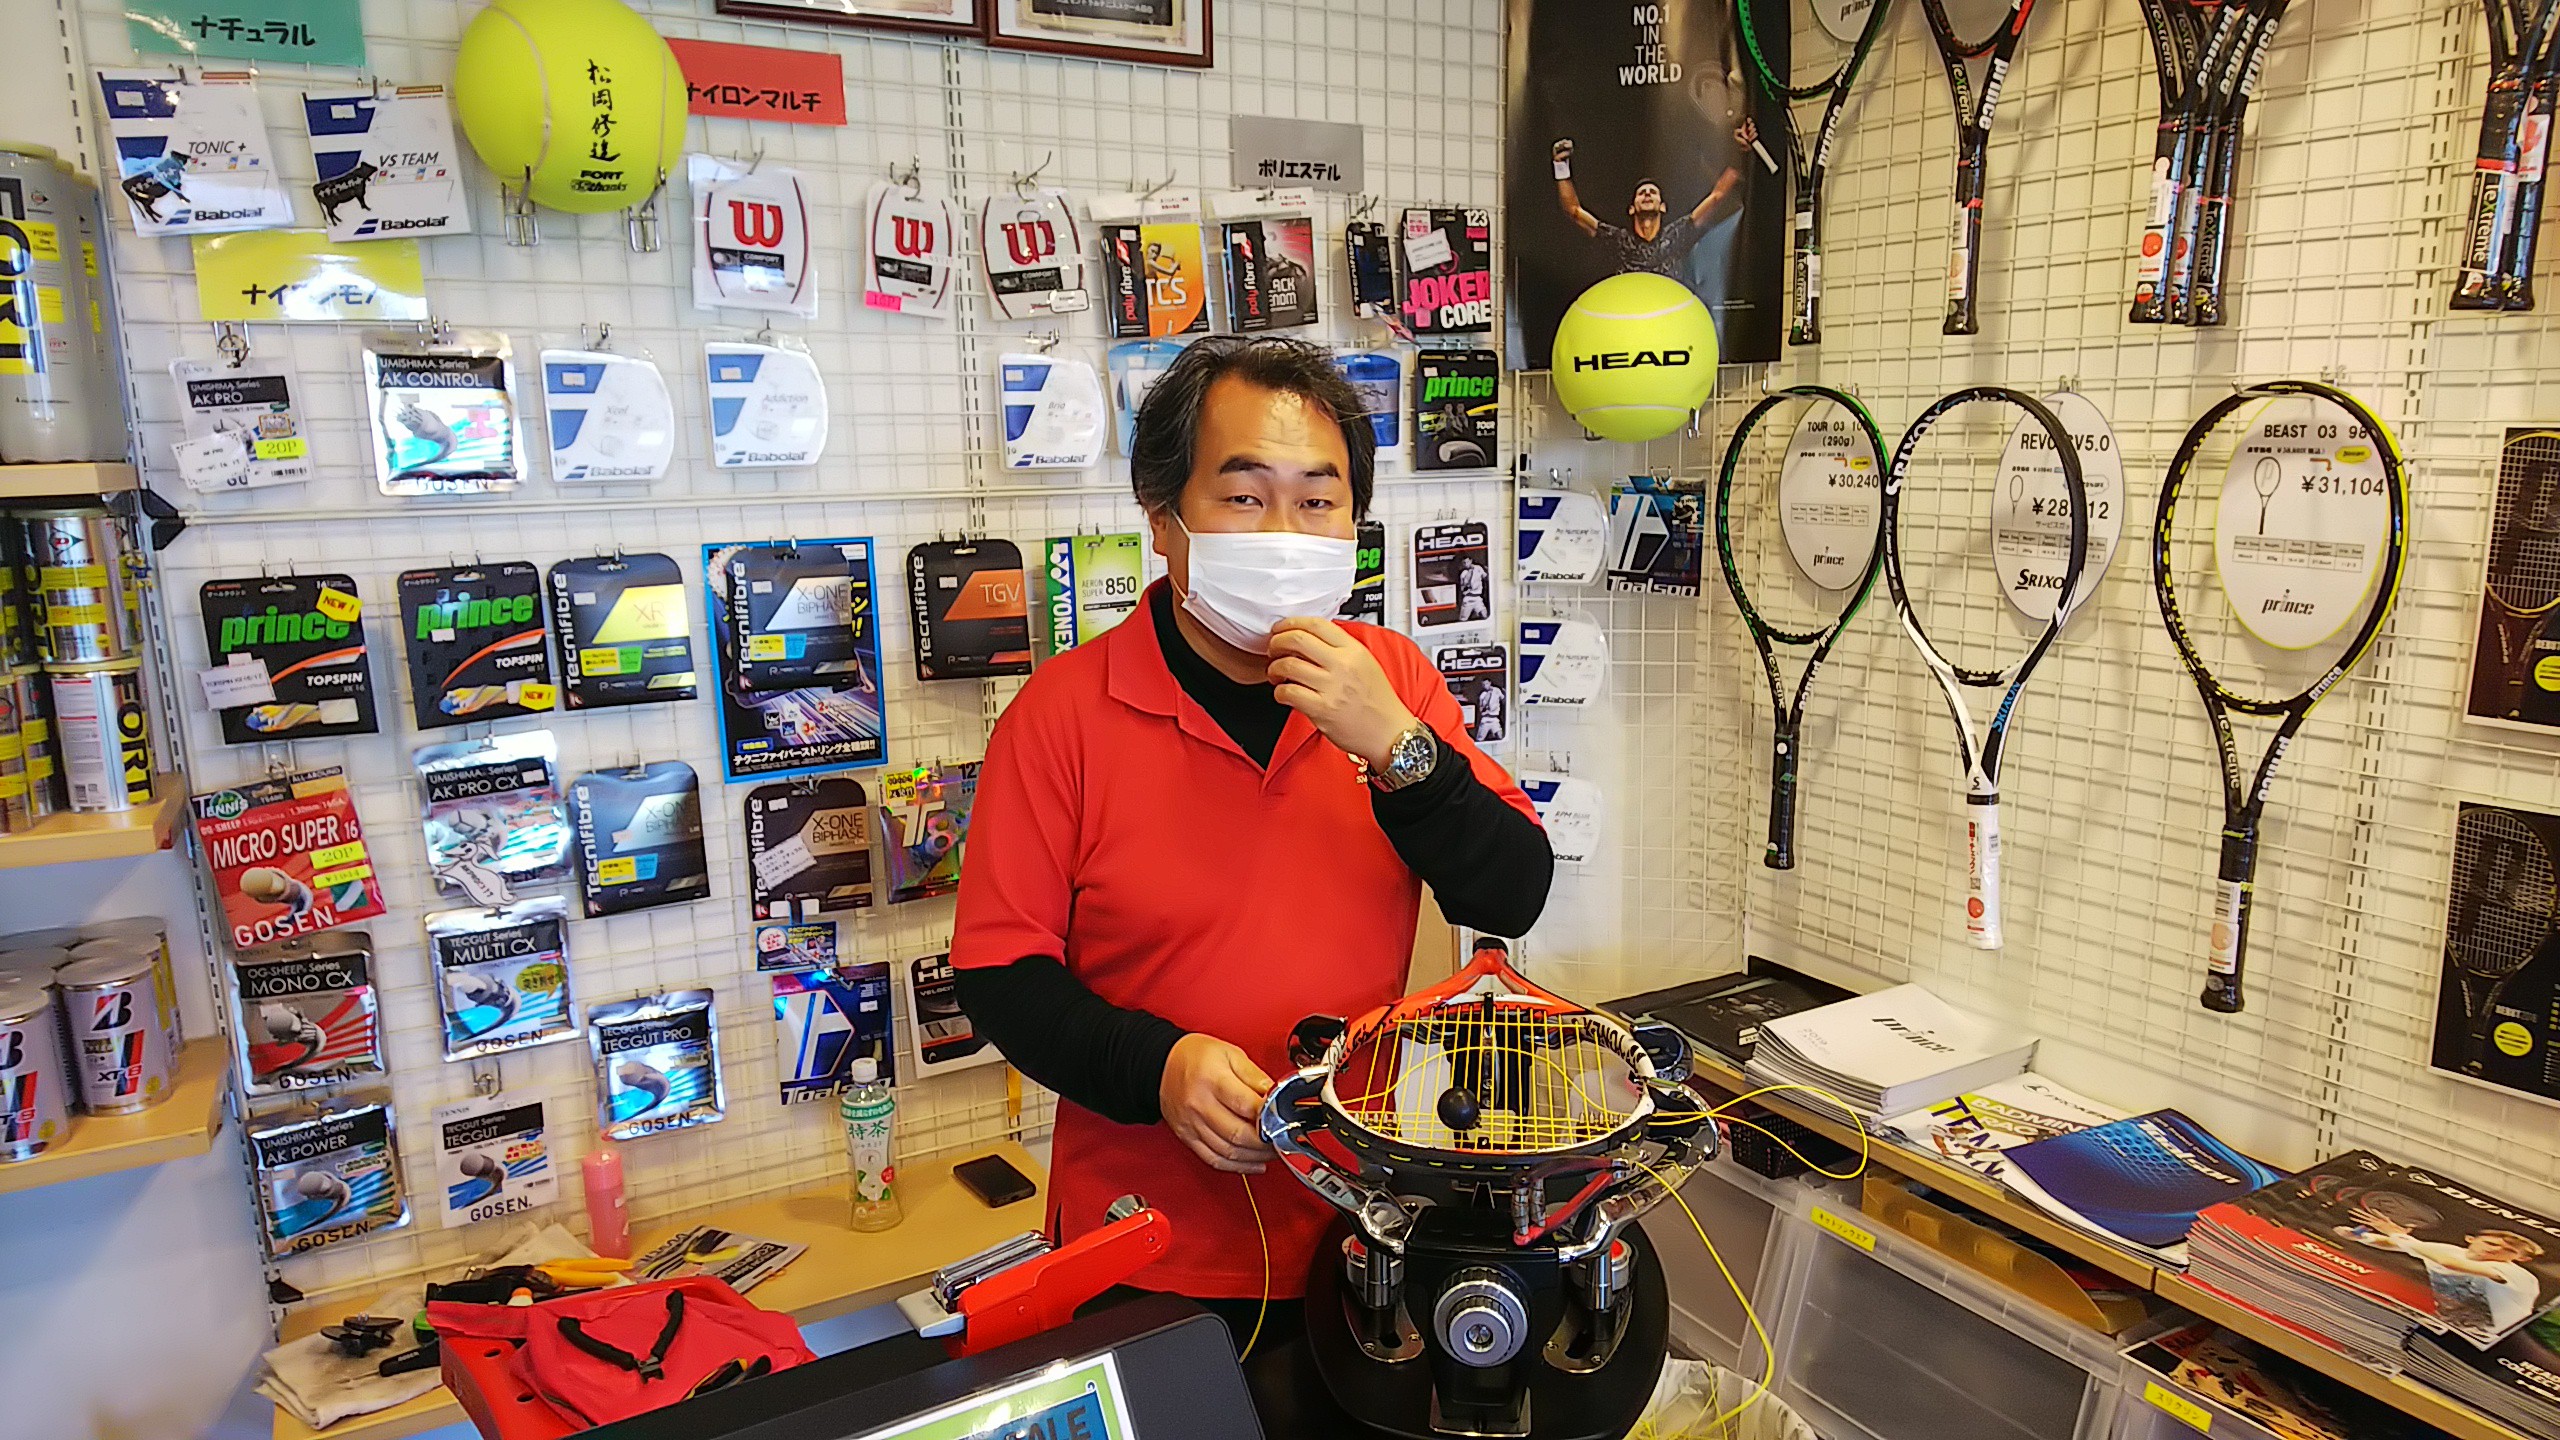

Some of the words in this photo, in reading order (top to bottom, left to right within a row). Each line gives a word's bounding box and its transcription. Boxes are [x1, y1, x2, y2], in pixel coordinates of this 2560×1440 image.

[1633, 4, 1670, 25] NO.1
[191, 15, 315, 47] ナチュラル
[1642, 26, 1660, 44] IN
[1635, 44, 1667, 63] THE
[2197, 4, 2236, 88] prince
[2220, 13, 2259, 95] prince
[2239, 17, 2279, 97] prince
[1619, 63, 1682, 86] WORLD
[687, 83, 822, 113] ナイロンマルチ
[1978, 57, 2010, 130] prince
[586, 58, 622, 163] 松岡修造
[1818, 105, 1843, 167] prince
[188, 141, 235, 155] TONIC
[380, 154, 397, 167] VS
[400, 152, 438, 166] TEAM
[1258, 159, 1340, 182] ポリエステル
[194, 207, 266, 221] Babolat
[380, 216, 449, 230] Babolat
[1464, 210, 1488, 227] 123
[1145, 277, 1187, 306] TCS
[1402, 271, 1491, 316] JOKER
[1440, 301, 1491, 329] CORE
[380, 358, 436, 370] UMISHIMA
[439, 359, 470, 370] Series
[1573, 350, 1690, 373] HEAD
[381, 373, 403, 386] AK
[407, 372, 482, 388] CONTROL
[1424, 369, 1494, 403] prince
[194, 395, 212, 405] AK
[215, 391, 243, 404] PRO
[1807, 421, 1828, 432] TOUR
[1833, 421, 1845, 432] 03
[2264, 425, 2308, 438] BEAST
[2317, 425, 2337, 438] 03
[2349, 426, 2368, 439] 98
[1822, 436, 1855, 447] (290g)
[748, 452, 808, 462] Babolat
[1035, 454, 1087, 464] Babolat
[591, 466, 654, 477] Babolat
[1828, 474, 1879, 488] ¥30,240
[2302, 475, 2385, 496] ¥31,104
[2032, 498, 2109, 519] ¥28,12
[1419, 533, 1486, 550] HEAD
[1813, 546, 1845, 566] prince
[1081, 579, 1104, 588] AERON
[1105, 576, 1137, 596] 850
[1608, 575, 1698, 596] Toalson
[2015, 568, 2066, 591] SRIXO
[322, 596, 346, 609] NEW
[797, 584, 849, 600] X-ONE
[980, 582, 1021, 604] TGV
[2262, 589, 2315, 615] prince
[416, 591, 534, 641] prince
[732, 561, 752, 673] Tecnifibre
[912, 553, 934, 661] Tecnifibre
[220, 606, 350, 652] prince
[554, 572, 581, 690] Tecnifibre
[1052, 590, 1074, 656] YONEX
[495, 653, 544, 668] TOPSPIN
[1440, 657, 1503, 671] HEAD
[306, 672, 363, 687] TOPSPIN
[1798, 660, 1823, 711] prince
[2309, 665, 2343, 700] prince
[524, 691, 543, 700] NEW
[1542, 696, 1587, 704] Babolat
[1992, 681, 2021, 733] SRIXON
[113, 674, 155, 801] FORT
[430, 769, 483, 784] UMISHIMA
[487, 764, 518, 776] Series
[2257, 736, 2291, 802] prince
[432, 787, 456, 800] AK
[458, 781, 491, 795] PRO
[495, 777, 519, 790] CX
[812, 812, 864, 830] X-ONE
[213, 829, 277, 869] MICRO
[281, 815, 340, 855] SUPER
[344, 821, 358, 840] 16
[577, 785, 602, 898] Tecnifibre
[812, 829, 865, 843] BIPHASE
[1554, 853, 1584, 862] bolat
[234, 905, 336, 947] GOSEN
[449, 934, 490, 947] TECGUT
[453, 943, 506, 964] MULTI
[510, 937, 537, 953] CX
[309, 960, 341, 975] Series
[918, 966, 954, 982] HE
[251, 974, 321, 998] MONO
[326, 970, 354, 988] CX
[476, 1029, 543, 1053] GOSEN
[603, 1030, 659, 1053] TECGUT
[662, 1026, 692, 1042] PRO
[1872, 1017, 1956, 1054] prince
[0, 1108, 36, 1126] T8
[445, 1119, 480, 1134] TECGUT
[629, 1112, 691, 1135] GOSEN
[446, 1125, 499, 1147] TECGUT
[848, 1120, 889, 1141] 特茶
[266, 1149, 289, 1166] AK
[291, 1134, 348, 1158] POWER
[2138, 1119, 2241, 1185] Toalson
[471, 1196, 529, 1222] GOSEN
[298, 1221, 369, 1252] GOSEN
[2293, 1242, 2377, 1276] SRIXON
